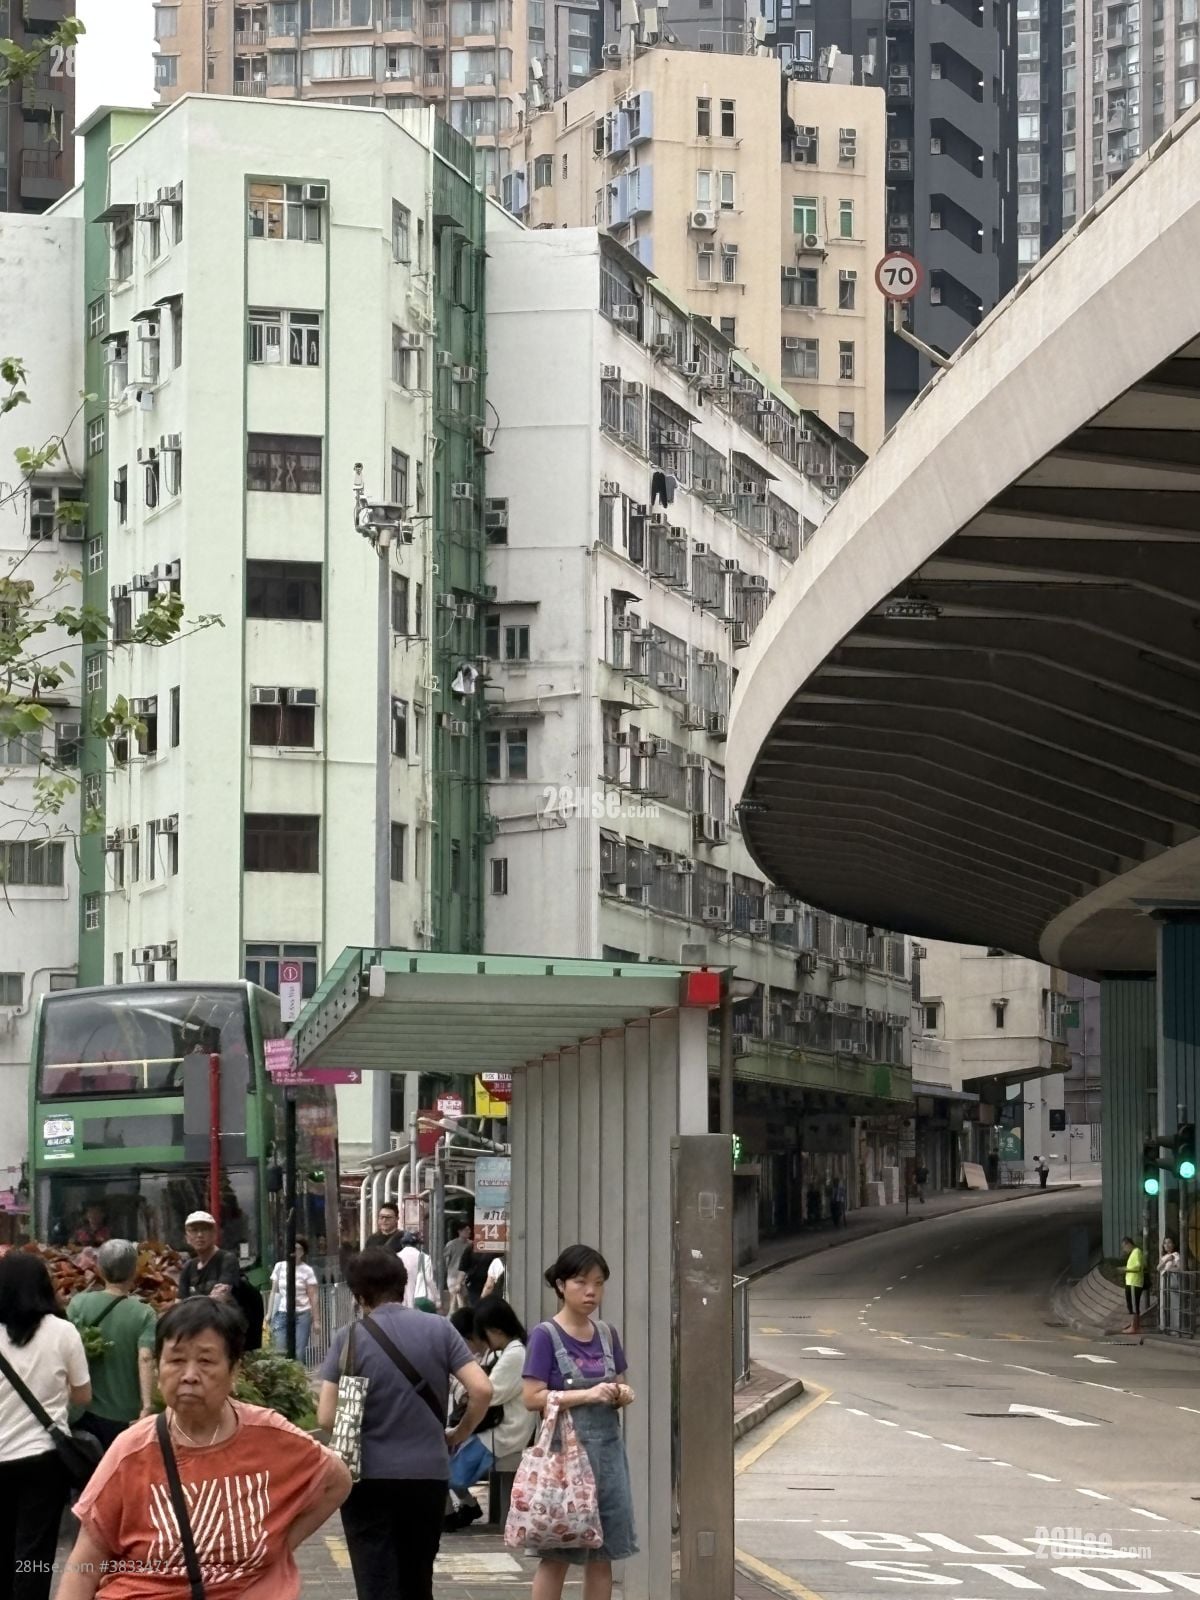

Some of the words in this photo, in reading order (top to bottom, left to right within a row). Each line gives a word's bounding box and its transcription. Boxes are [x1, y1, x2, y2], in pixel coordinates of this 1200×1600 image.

[884, 267, 914, 286] 70
[481, 1224, 500, 1240] 14
[816, 1530, 1141, 1558] BUS
